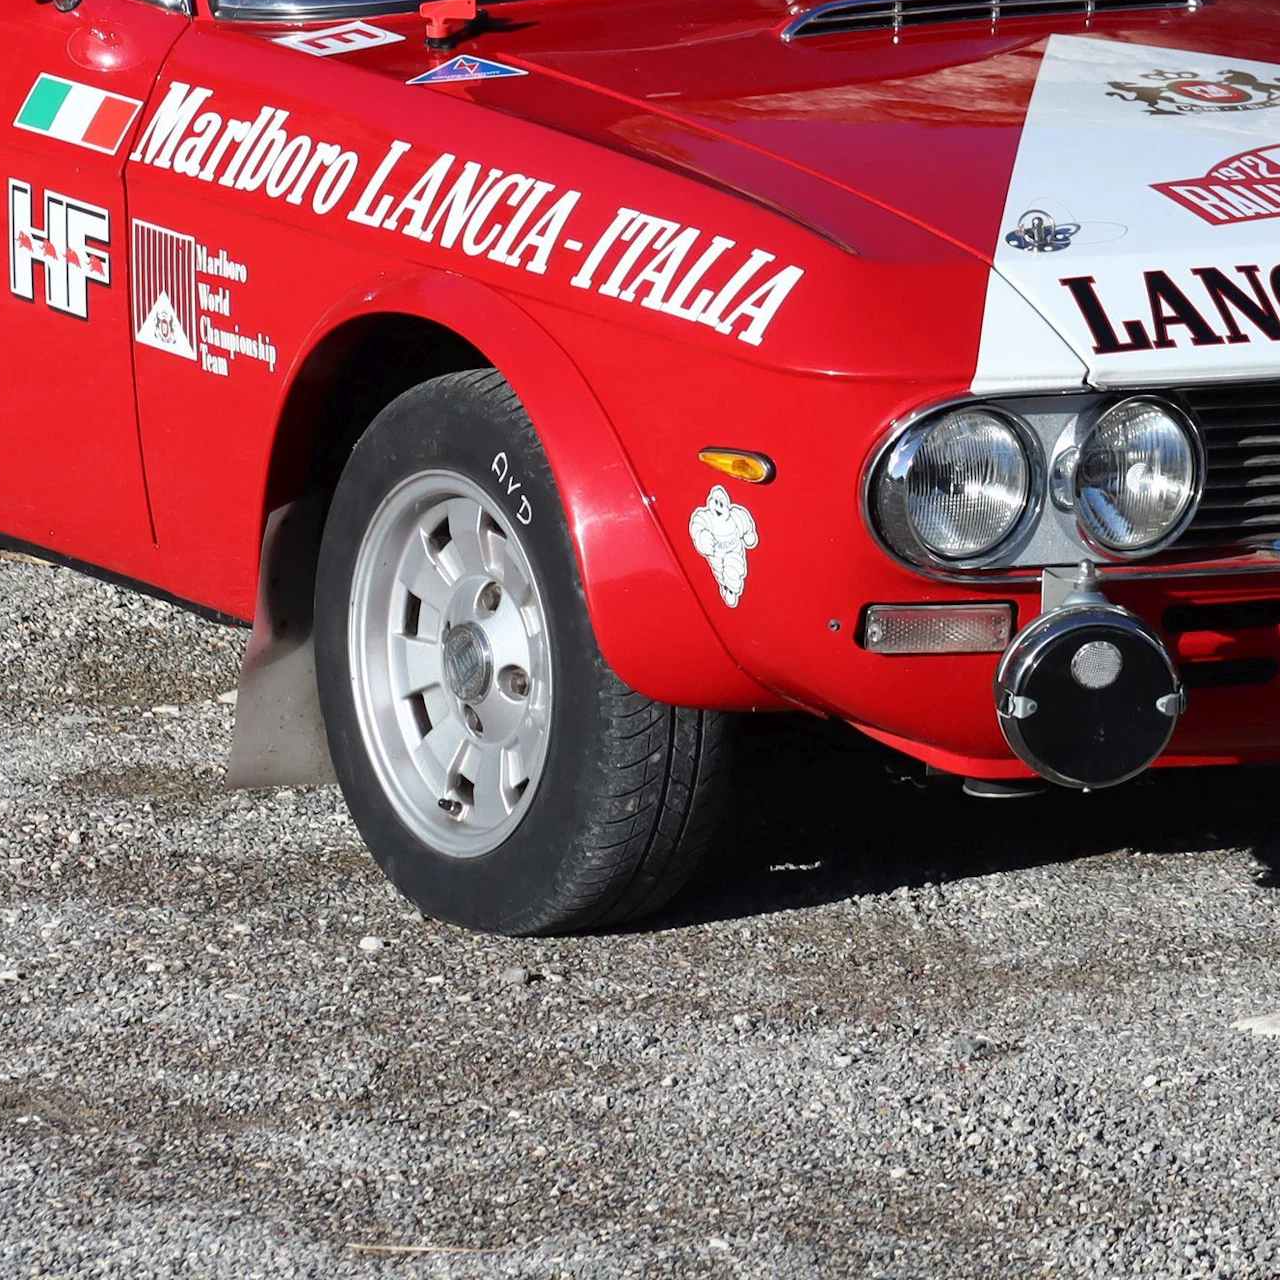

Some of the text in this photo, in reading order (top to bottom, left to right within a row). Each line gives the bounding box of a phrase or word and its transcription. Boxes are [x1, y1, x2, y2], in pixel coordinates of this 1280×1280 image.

[297, 28, 380, 50] E
[128, 80, 360, 216] Marlboro
[7, 176, 111, 322] HF
[197, 245, 247, 283] Marlboro
[199, 283, 230, 317] World
[200, 315, 277, 372] Championship
[200, 344, 228, 376] Team
